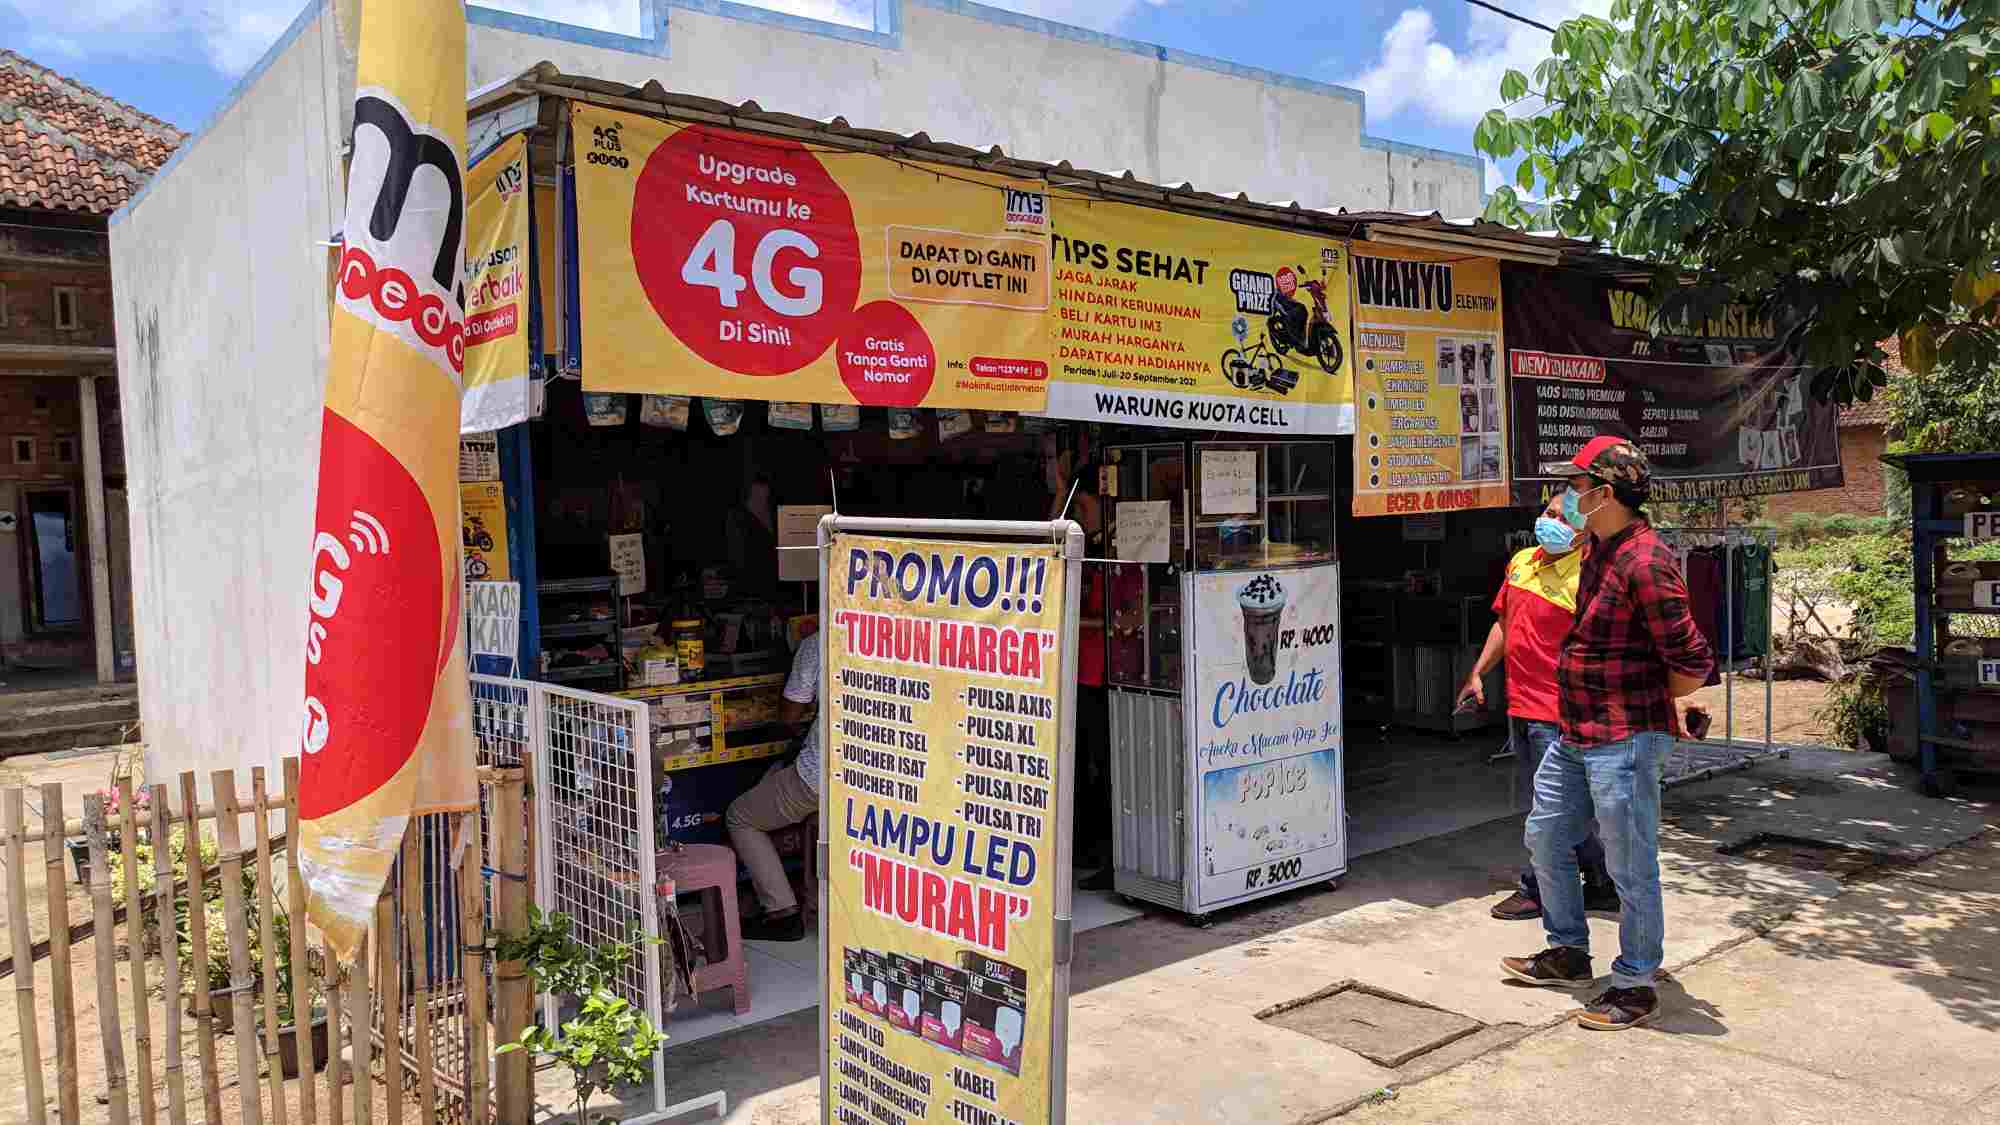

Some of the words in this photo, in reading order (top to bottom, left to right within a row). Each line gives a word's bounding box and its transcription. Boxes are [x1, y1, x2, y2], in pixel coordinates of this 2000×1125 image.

[699, 153, 797, 187] Upgrade
[686, 184, 782, 216] Kartumu
[786, 196, 811, 220] ke
[681, 218, 823, 318] 4G
[900, 241, 960, 265] DAPAT
[964, 248, 983, 265] DI
[985, 250, 1036, 271] GANTI
[1052, 234, 1109, 269] TIPS
[1117, 247, 1209, 284] SEHAT
[911, 268, 932, 285] DI
[935, 271, 1002, 290] OUTLET
[1006, 275, 1027, 293] INI
[1056, 269, 1093, 285] JAGA
[1097, 276, 1137, 292] JARAK
[1232, 272, 1272, 294] GRAND
[1355, 257, 1453, 312] WAHYU
[1058, 290, 1118, 307] HINDARI
[1121, 298, 1201, 319] KERUMUNAN
[1238, 291, 1270, 312] PRIZE
[719, 320, 742, 341] Di
[747, 322, 792, 346] Sini!
[1060, 308, 1088, 321] BELI
[1094, 312, 1137, 328] KARTU
[1140, 319, 1162, 332] IM3
[865, 337, 905, 353] Gratis
[1061, 328, 1112, 345] MURAH
[1117, 335, 1185, 353] HARGANYA
[845, 352, 887, 371] Tanpa
[890, 354, 928, 369] Ganti
[1059, 347, 1134, 366] DAPATKAN
[1136, 355, 1211, 374] HADIAHNYA
[864, 368, 911, 384] Nomor
[1133, 372, 1177, 384] September
[1537, 384, 1561, 399] KAOS
[1586, 389, 1625, 402] PREMIUM
[1095, 393, 1184, 420] WARUNG
[1188, 401, 1246, 424] KUOTA
[1250, 406, 1288, 426] CELL
[1537, 405, 1558, 418] KAOS
[1538, 424, 1558, 437] KAOS
[1387, 492, 1420, 512] ECER
[847, 548, 1047, 613] PROMO!!!
[836, 611, 931, 664] "TURUN
[939, 622, 1054, 679] HARGA"
[1280, 629, 1299, 650] RP.
[1303, 624, 1334, 646] 4000
[842, 669, 896, 695] VOUCHER
[900, 679, 930, 700] AXIS
[1213, 668, 1327, 728] Chocolate
[842, 694, 896, 721] VOUCHER
[898, 705, 913, 723] XL
[968, 687, 1014, 710] PULSA
[1018, 695, 1052, 719] AXIS
[843, 718, 895, 747] VOUCHER
[899, 730, 928, 753] TSEL
[967, 716, 1013, 740] PULSA
[1017, 725, 1036, 746] XL
[1243, 733, 1289, 758] Macam
[843, 743, 895, 771] VOUCHER
[898, 756, 926, 778] ISAT
[966, 745, 1013, 772] PULSA
[1017, 754, 1050, 780] TSEL
[843, 768, 894, 797] VOUCHER
[897, 782, 918, 803] TRI
[965, 774, 1012, 801] PULSA
[1016, 786, 1049, 809] ISAT
[964, 802, 1012, 831] PULSA
[1016, 813, 1041, 838] TRI
[846, 798, 955, 866] LAMPU
[963, 830, 1036, 886] LED
[1246, 867, 1264, 889] RP.
[850, 850, 1029, 951] "MURAH"
[840, 1008, 867, 1039] LAMPU
[869, 1024, 884, 1048] LED
[840, 1034, 867, 1064] LAMPU
[869, 1049, 931, 1096] BERGARANSI
[840, 1059, 868, 1088] LAMPU
[870, 1073, 927, 1119] EMERGENCY
[840, 1084, 868, 1112] LAMPU
[954, 1066, 997, 1102] KABEL
